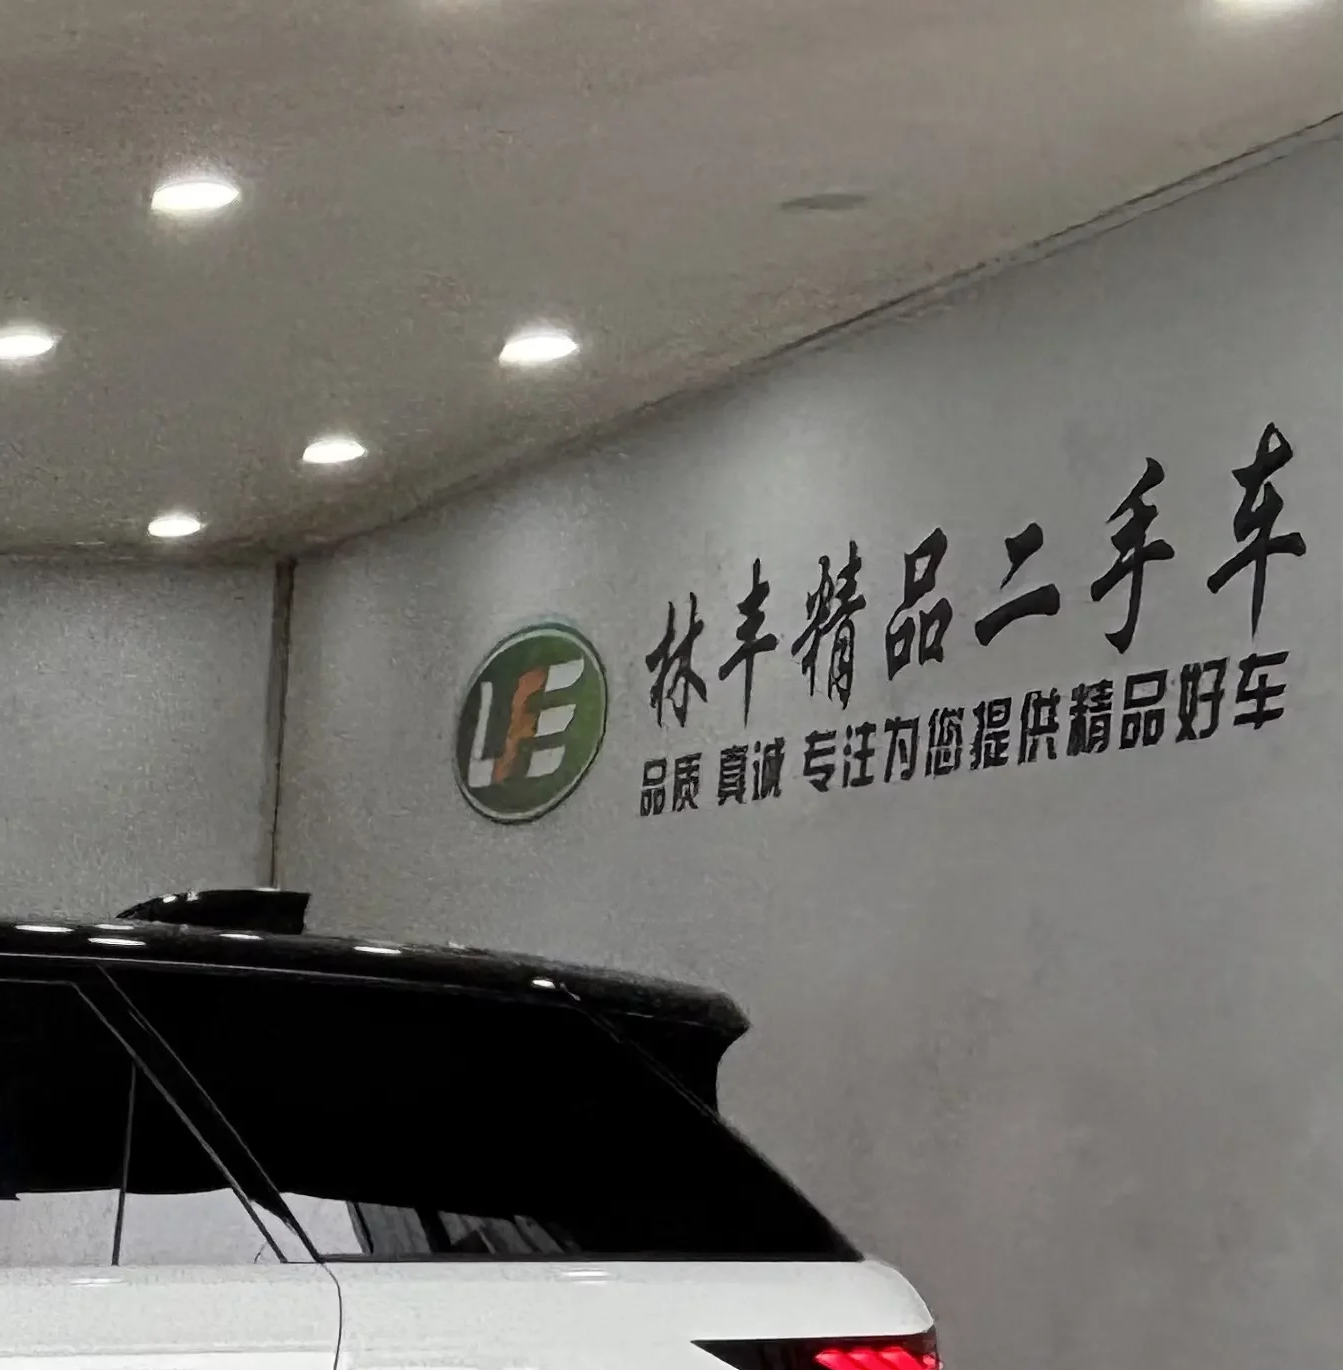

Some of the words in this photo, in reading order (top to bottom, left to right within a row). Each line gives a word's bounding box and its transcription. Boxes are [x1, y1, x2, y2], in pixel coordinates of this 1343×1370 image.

[645, 421, 1307, 729] 林丰精品二手车
[638, 751, 704, 818] 品质
[716, 735, 786, 808] 真诚
[801, 649, 1291, 794] 专注为您提供精品好车
